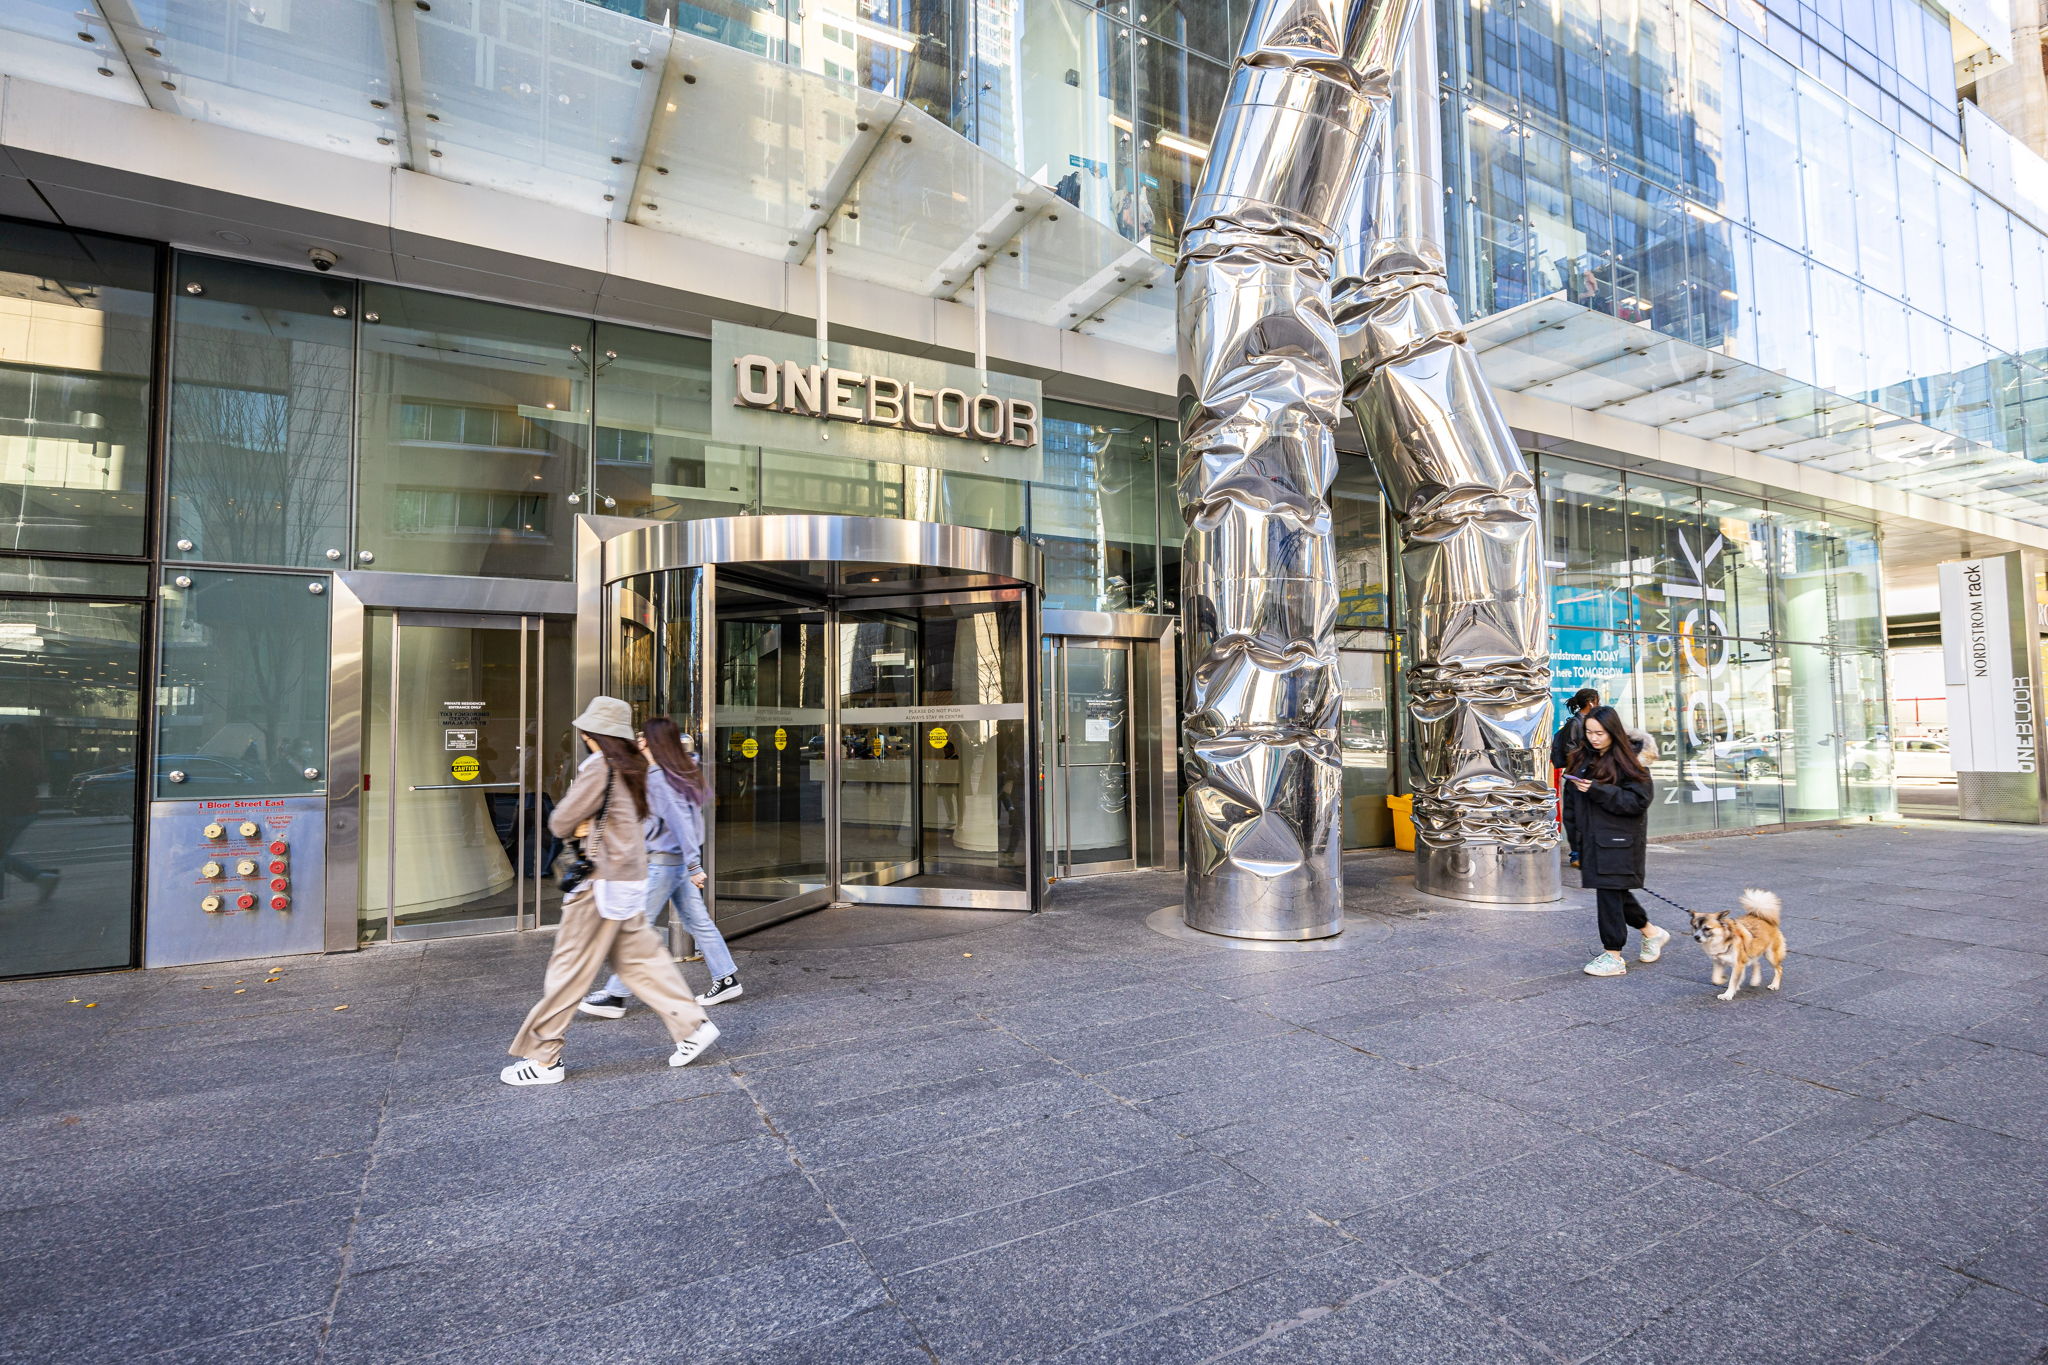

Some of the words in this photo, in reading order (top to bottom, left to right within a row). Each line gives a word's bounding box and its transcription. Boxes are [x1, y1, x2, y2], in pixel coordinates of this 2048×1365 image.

[734, 354, 1038, 448] ONEBLOOR
[1963, 565, 1982, 598] rack
[1550, 649, 1591, 661] ordstrom.ca
[1592, 650, 1619, 662] TODAY
[1556, 666, 1573, 677] here
[1573, 667, 1624, 678] TOMORROW
[1662, 528, 1736, 803] rack
[1970, 601, 1987, 677] NORDSTROM
[1656, 607, 1679, 805] NORDSTROM
[2013, 676, 2036, 774] ONEBLOOR
[207, 801, 231, 809] Bloor
